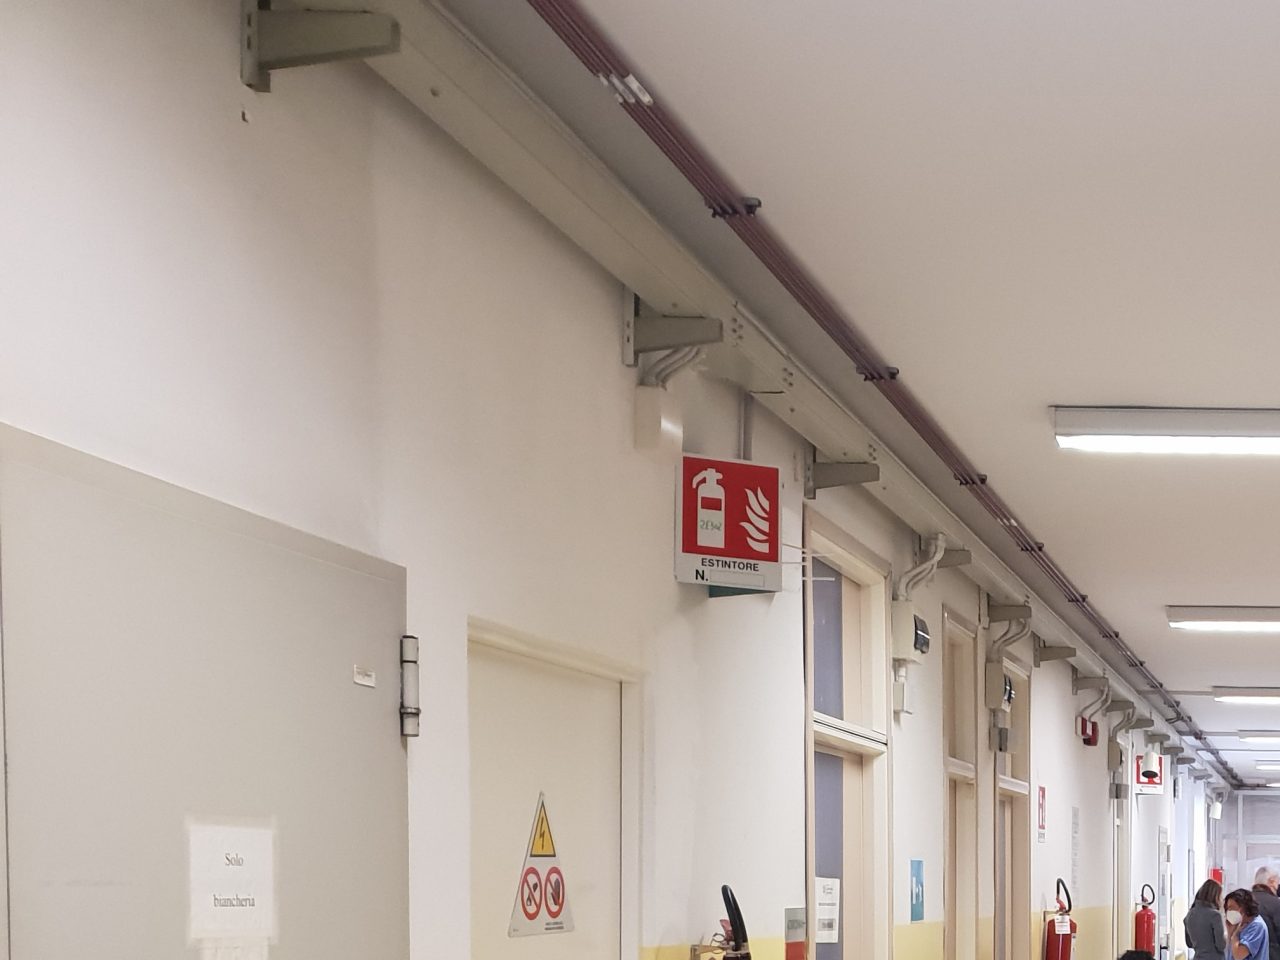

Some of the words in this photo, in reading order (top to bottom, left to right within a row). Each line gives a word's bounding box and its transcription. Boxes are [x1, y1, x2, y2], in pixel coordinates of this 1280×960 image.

[701, 558, 759, 572] ESTINTORE
[695, 569, 709, 582] N.
[225, 853, 244, 866] Solo
[213, 893, 255, 907] biancheria
